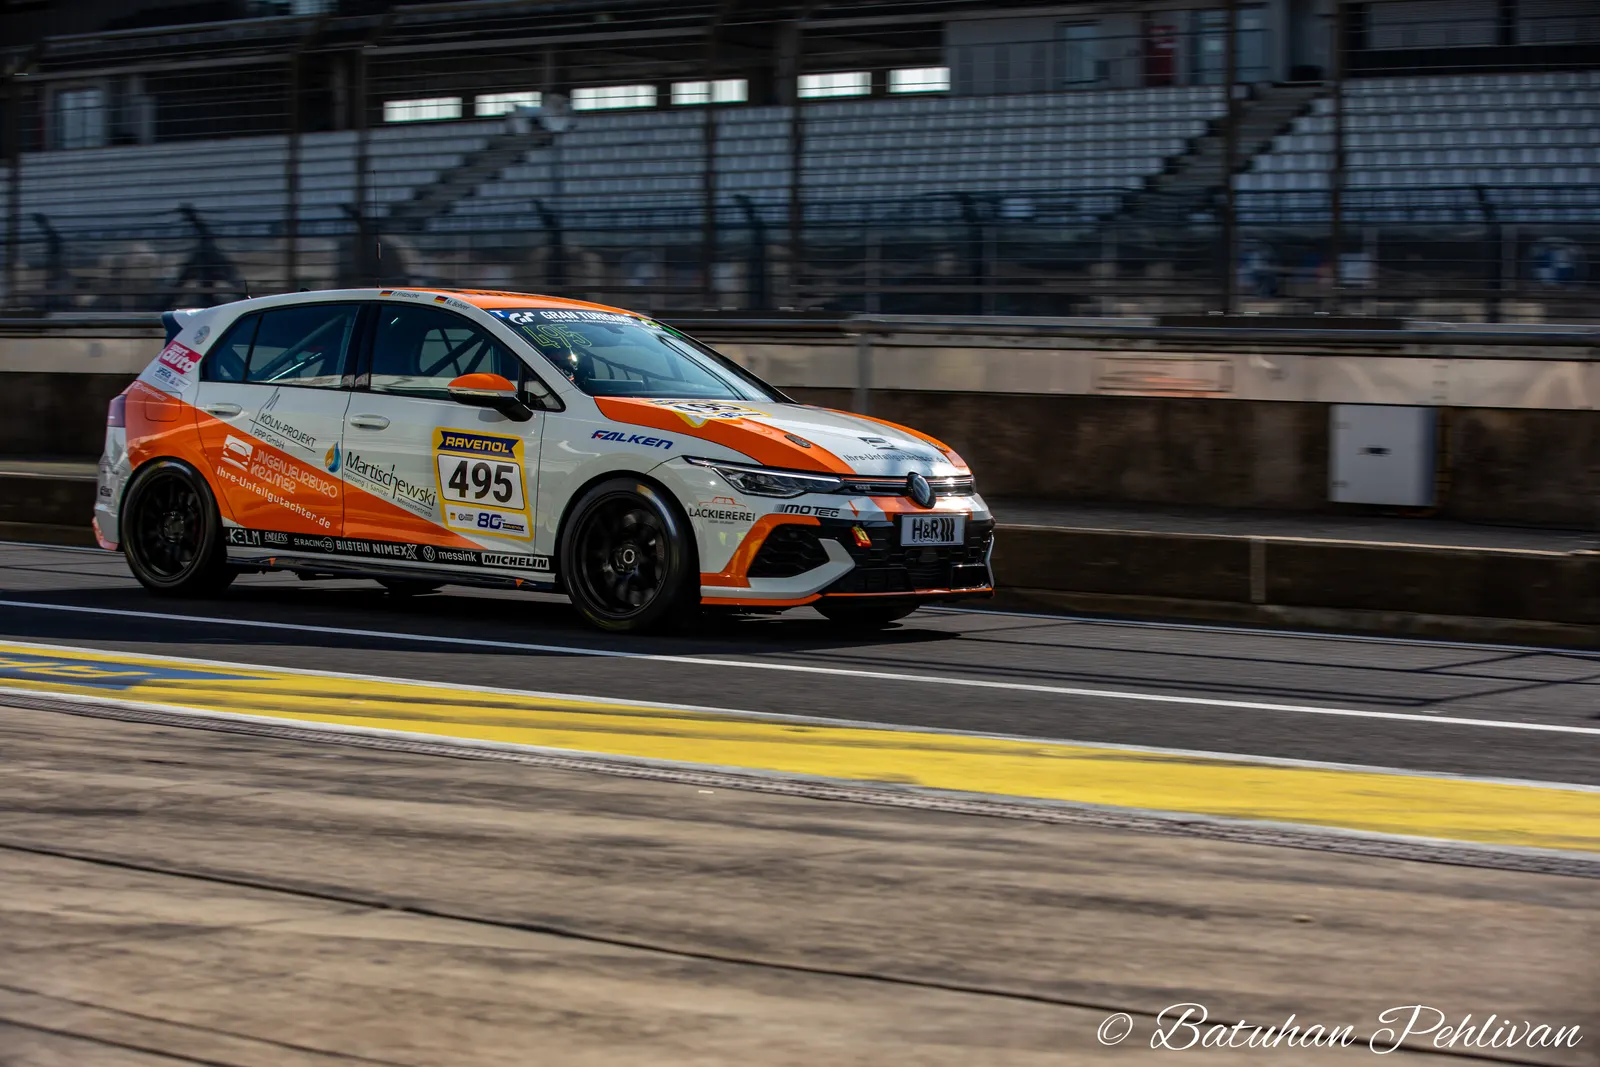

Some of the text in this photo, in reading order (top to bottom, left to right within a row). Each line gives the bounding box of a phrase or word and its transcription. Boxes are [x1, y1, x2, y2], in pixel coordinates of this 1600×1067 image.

[539, 310, 578, 320] GRAN
[161, 350, 196, 373] auto
[259, 413, 317, 447] KÖLN-PROJEKT
[265, 434, 286, 450] GmbH
[445, 436, 510, 453] RAVENOL
[590, 429, 674, 450] FALKEN
[345, 451, 437, 507] Martischewski
[448, 460, 514, 503] 495
[216, 465, 331, 529] Ihre-Unfallgutachter.de
[688, 508, 756, 521] LACKIEREREI
[784, 504, 840, 518] MOTEC
[229, 528, 261, 546] KELM
[264, 531, 288, 542] ENDLESS
[911, 517, 940, 543] H&R
[336, 540, 370, 553] BILSTEIN
[438, 550, 477, 562] messink
[484, 554, 548, 568] MICHELIN
